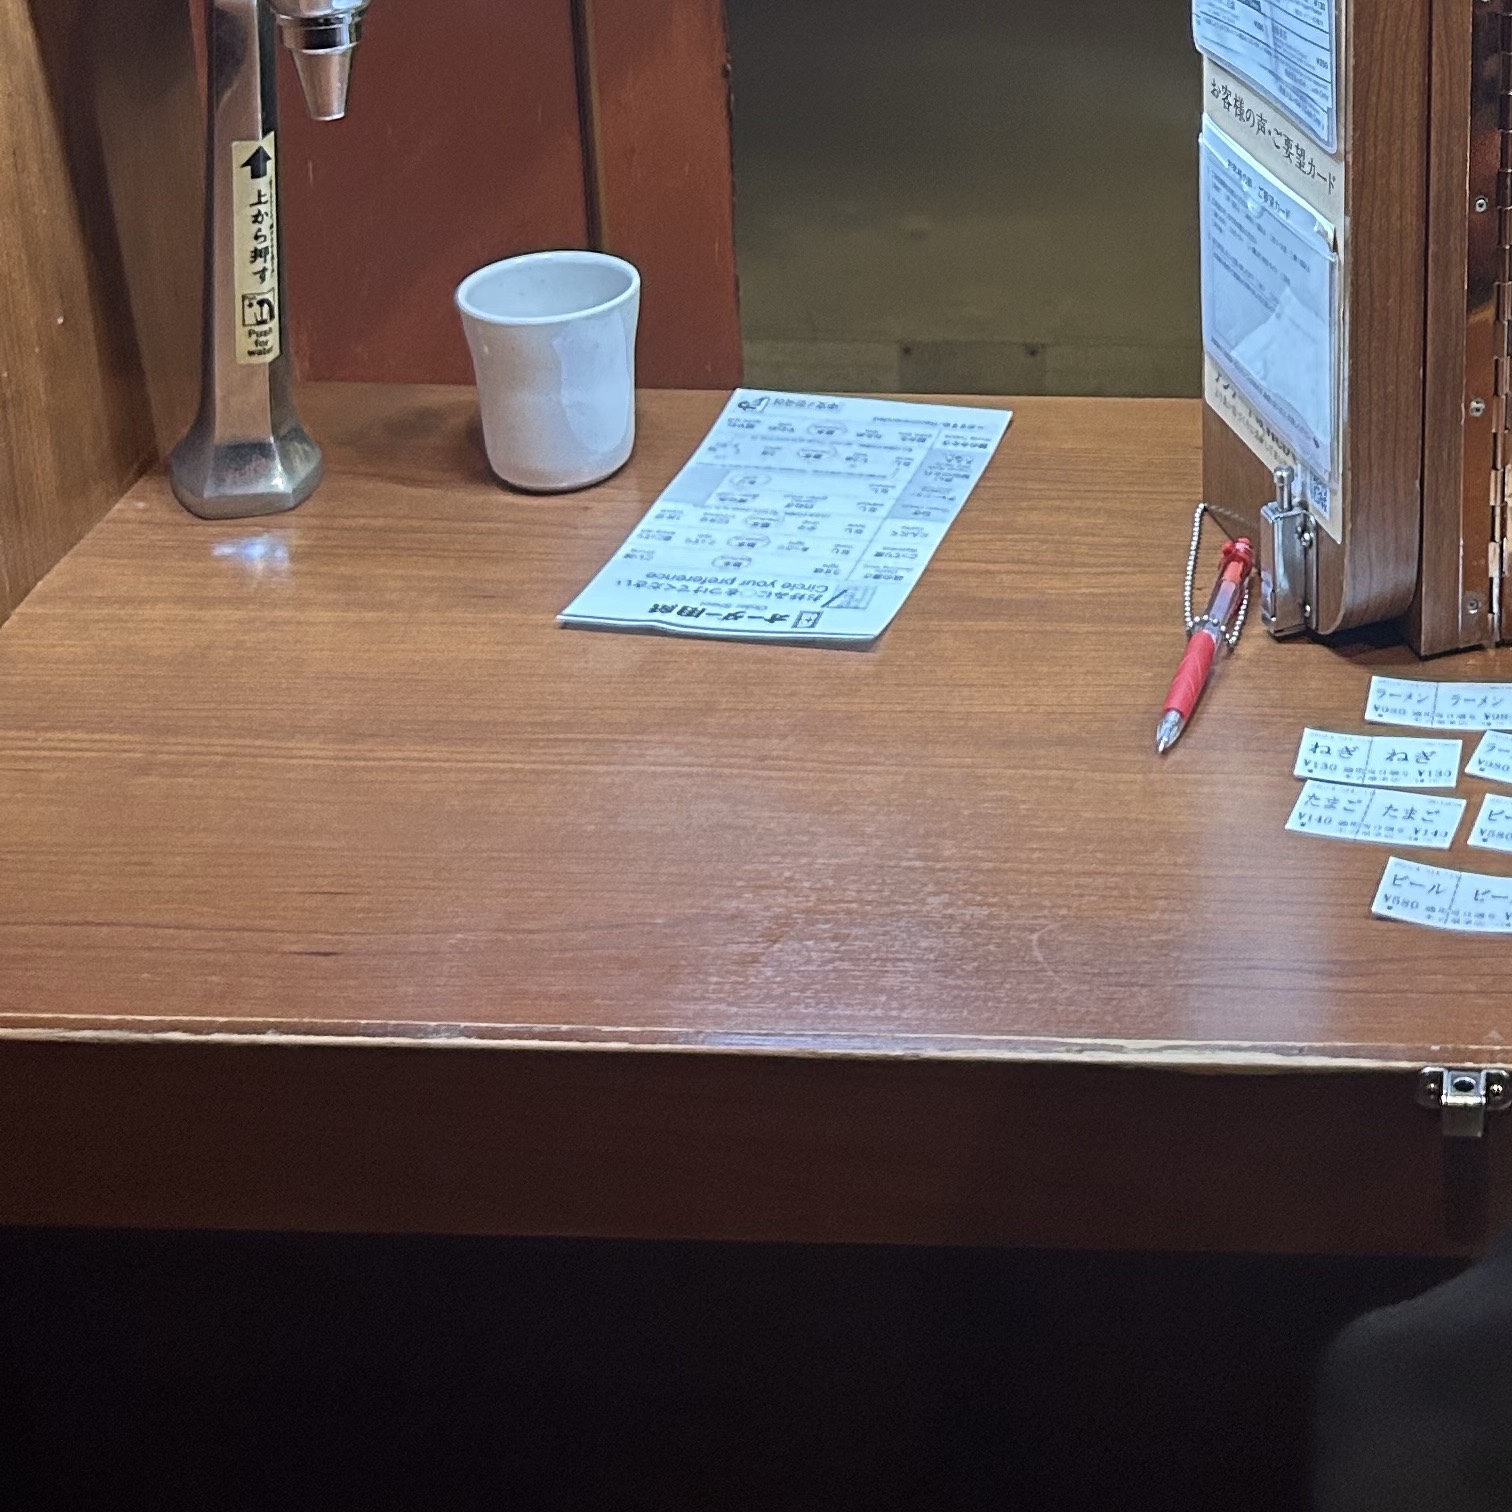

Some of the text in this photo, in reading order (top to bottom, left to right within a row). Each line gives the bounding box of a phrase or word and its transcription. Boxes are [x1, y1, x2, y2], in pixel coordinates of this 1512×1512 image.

[1211, 78, 1337, 195] お客様の声・ご要望カード
[249, 188, 270, 285] 上から押す
[253, 338, 270, 348] for
[646, 572, 829, 593] Circle your preference
[648, 602, 791, 624] オーダー用紙
[1375, 688, 1504, 707] ラーメン ラーメン
[1308, 742, 1437, 765] ねぎ ねぎ
[1303, 759, 1452, 778] ¥130 ¥130
[1304, 792, 1441, 824] たまご たまご
[1392, 873, 1447, 895] ビール
